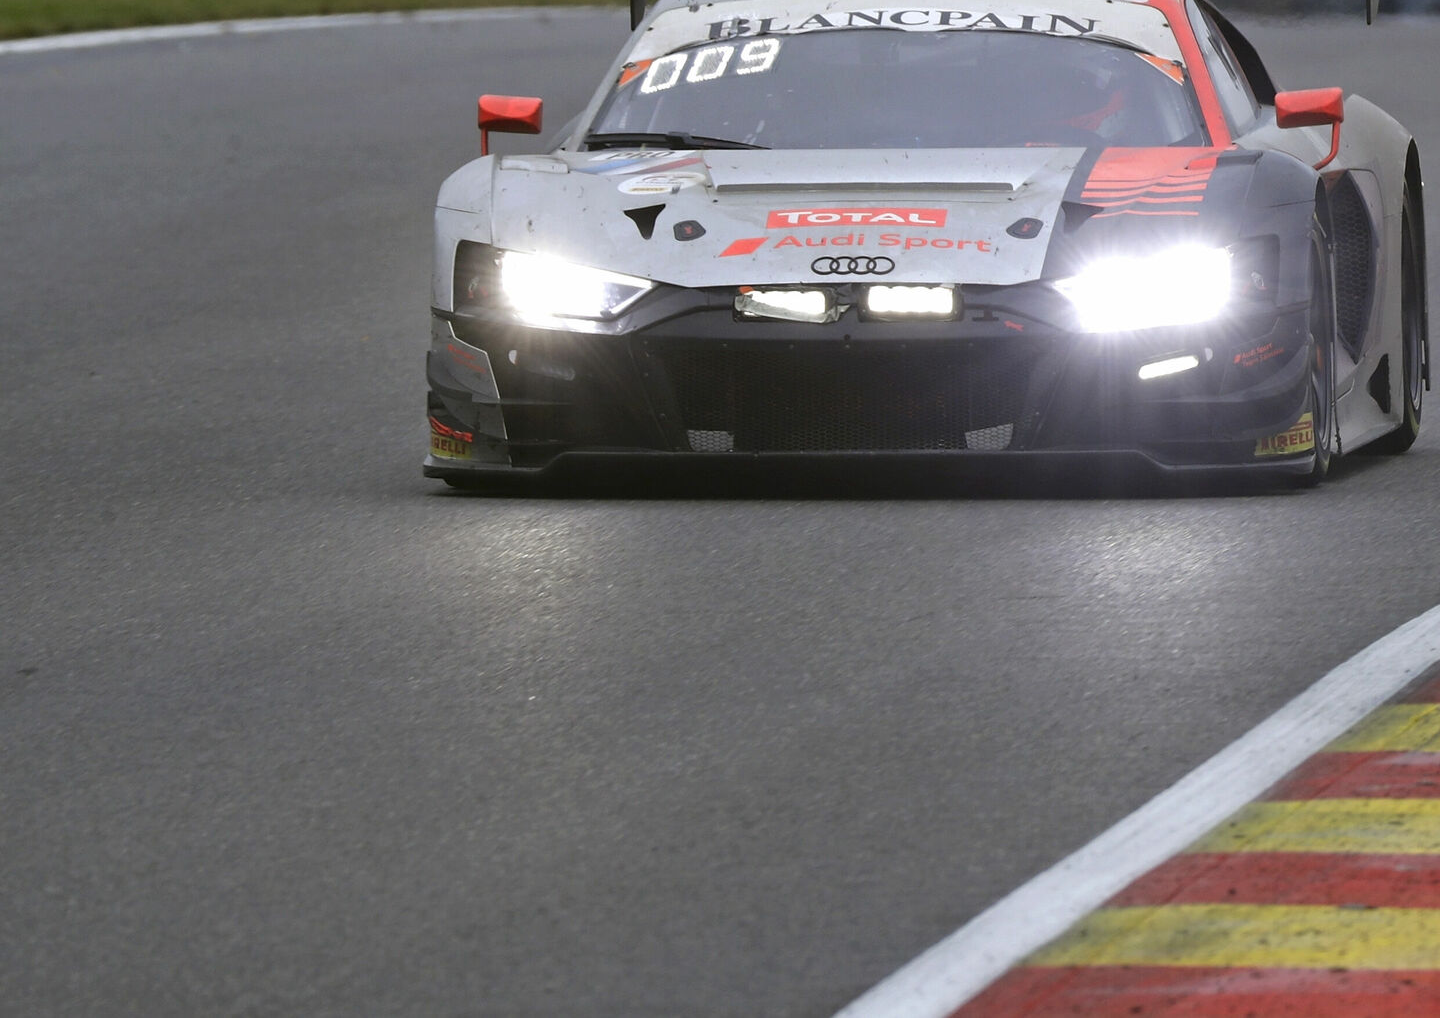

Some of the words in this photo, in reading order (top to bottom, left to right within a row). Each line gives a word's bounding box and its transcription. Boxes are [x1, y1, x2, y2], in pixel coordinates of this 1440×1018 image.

[706, 10, 1102, 39] BLANCPAIN
[640, 37, 782, 94] 009
[773, 232, 865, 249] Audi
[878, 233, 992, 253] Sport
